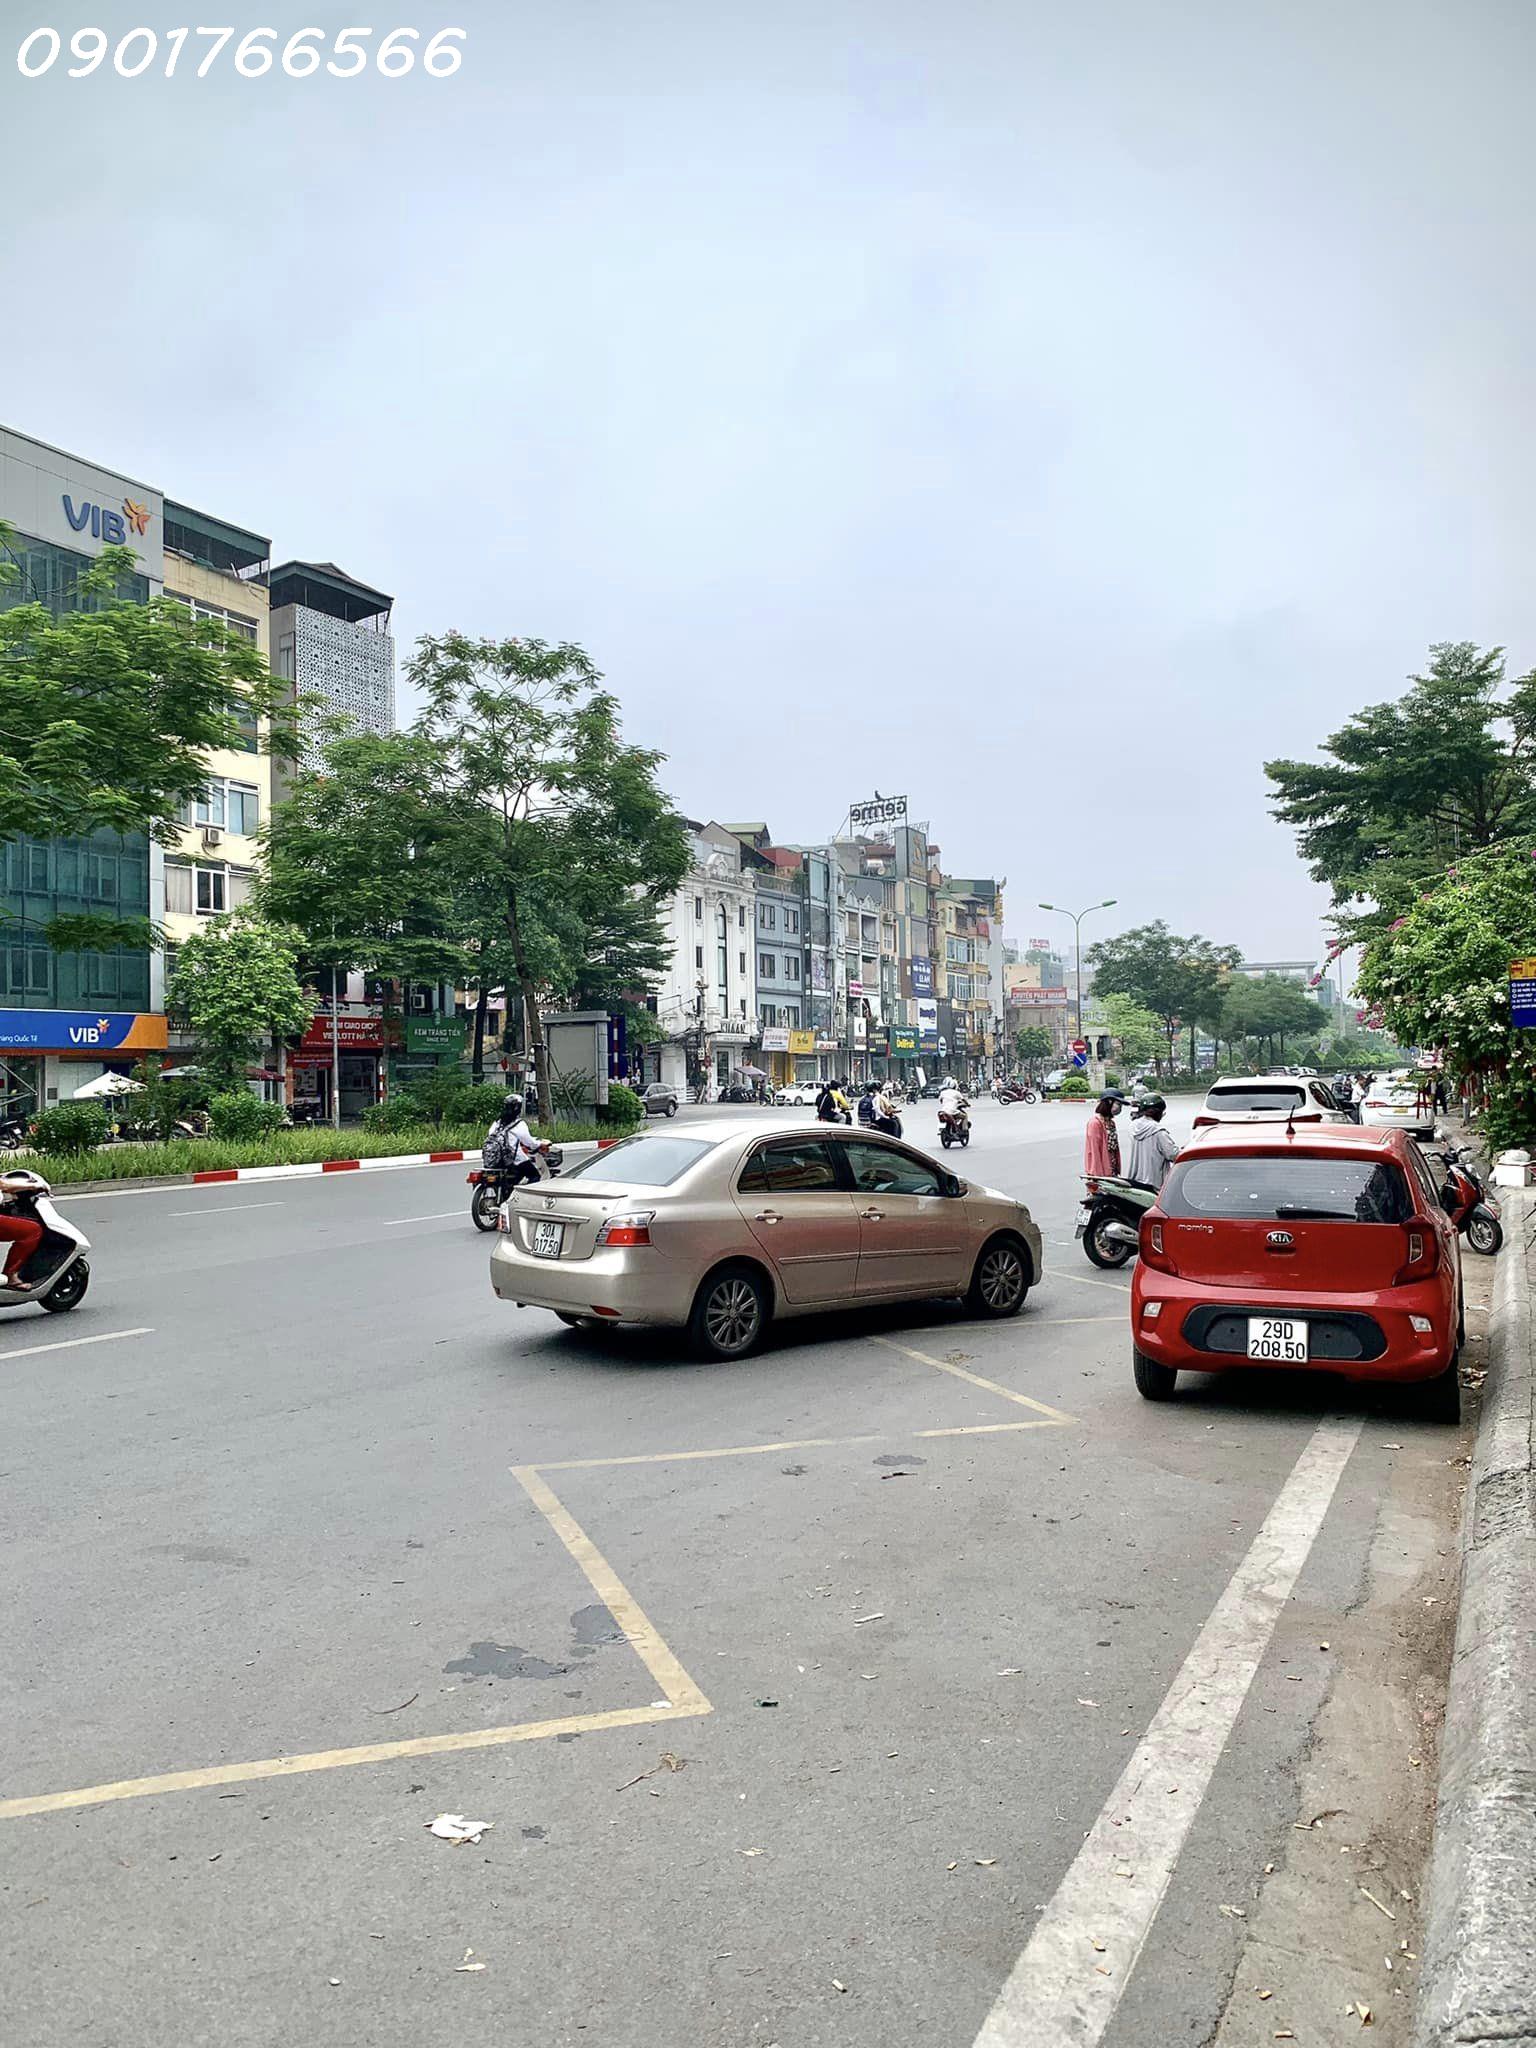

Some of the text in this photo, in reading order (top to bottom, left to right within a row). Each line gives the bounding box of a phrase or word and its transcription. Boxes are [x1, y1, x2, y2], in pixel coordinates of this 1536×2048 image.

[62, 494, 126, 545] VIB
[70, 1027, 99, 1043] VIB
[541, 1223, 556, 1239] 30A
[1178, 1224, 1214, 1234] morning
[1270, 1234, 1290, 1242] KIA
[1262, 1321, 1293, 1339] 29D
[1250, 1340, 1305, 1359] 208.50
